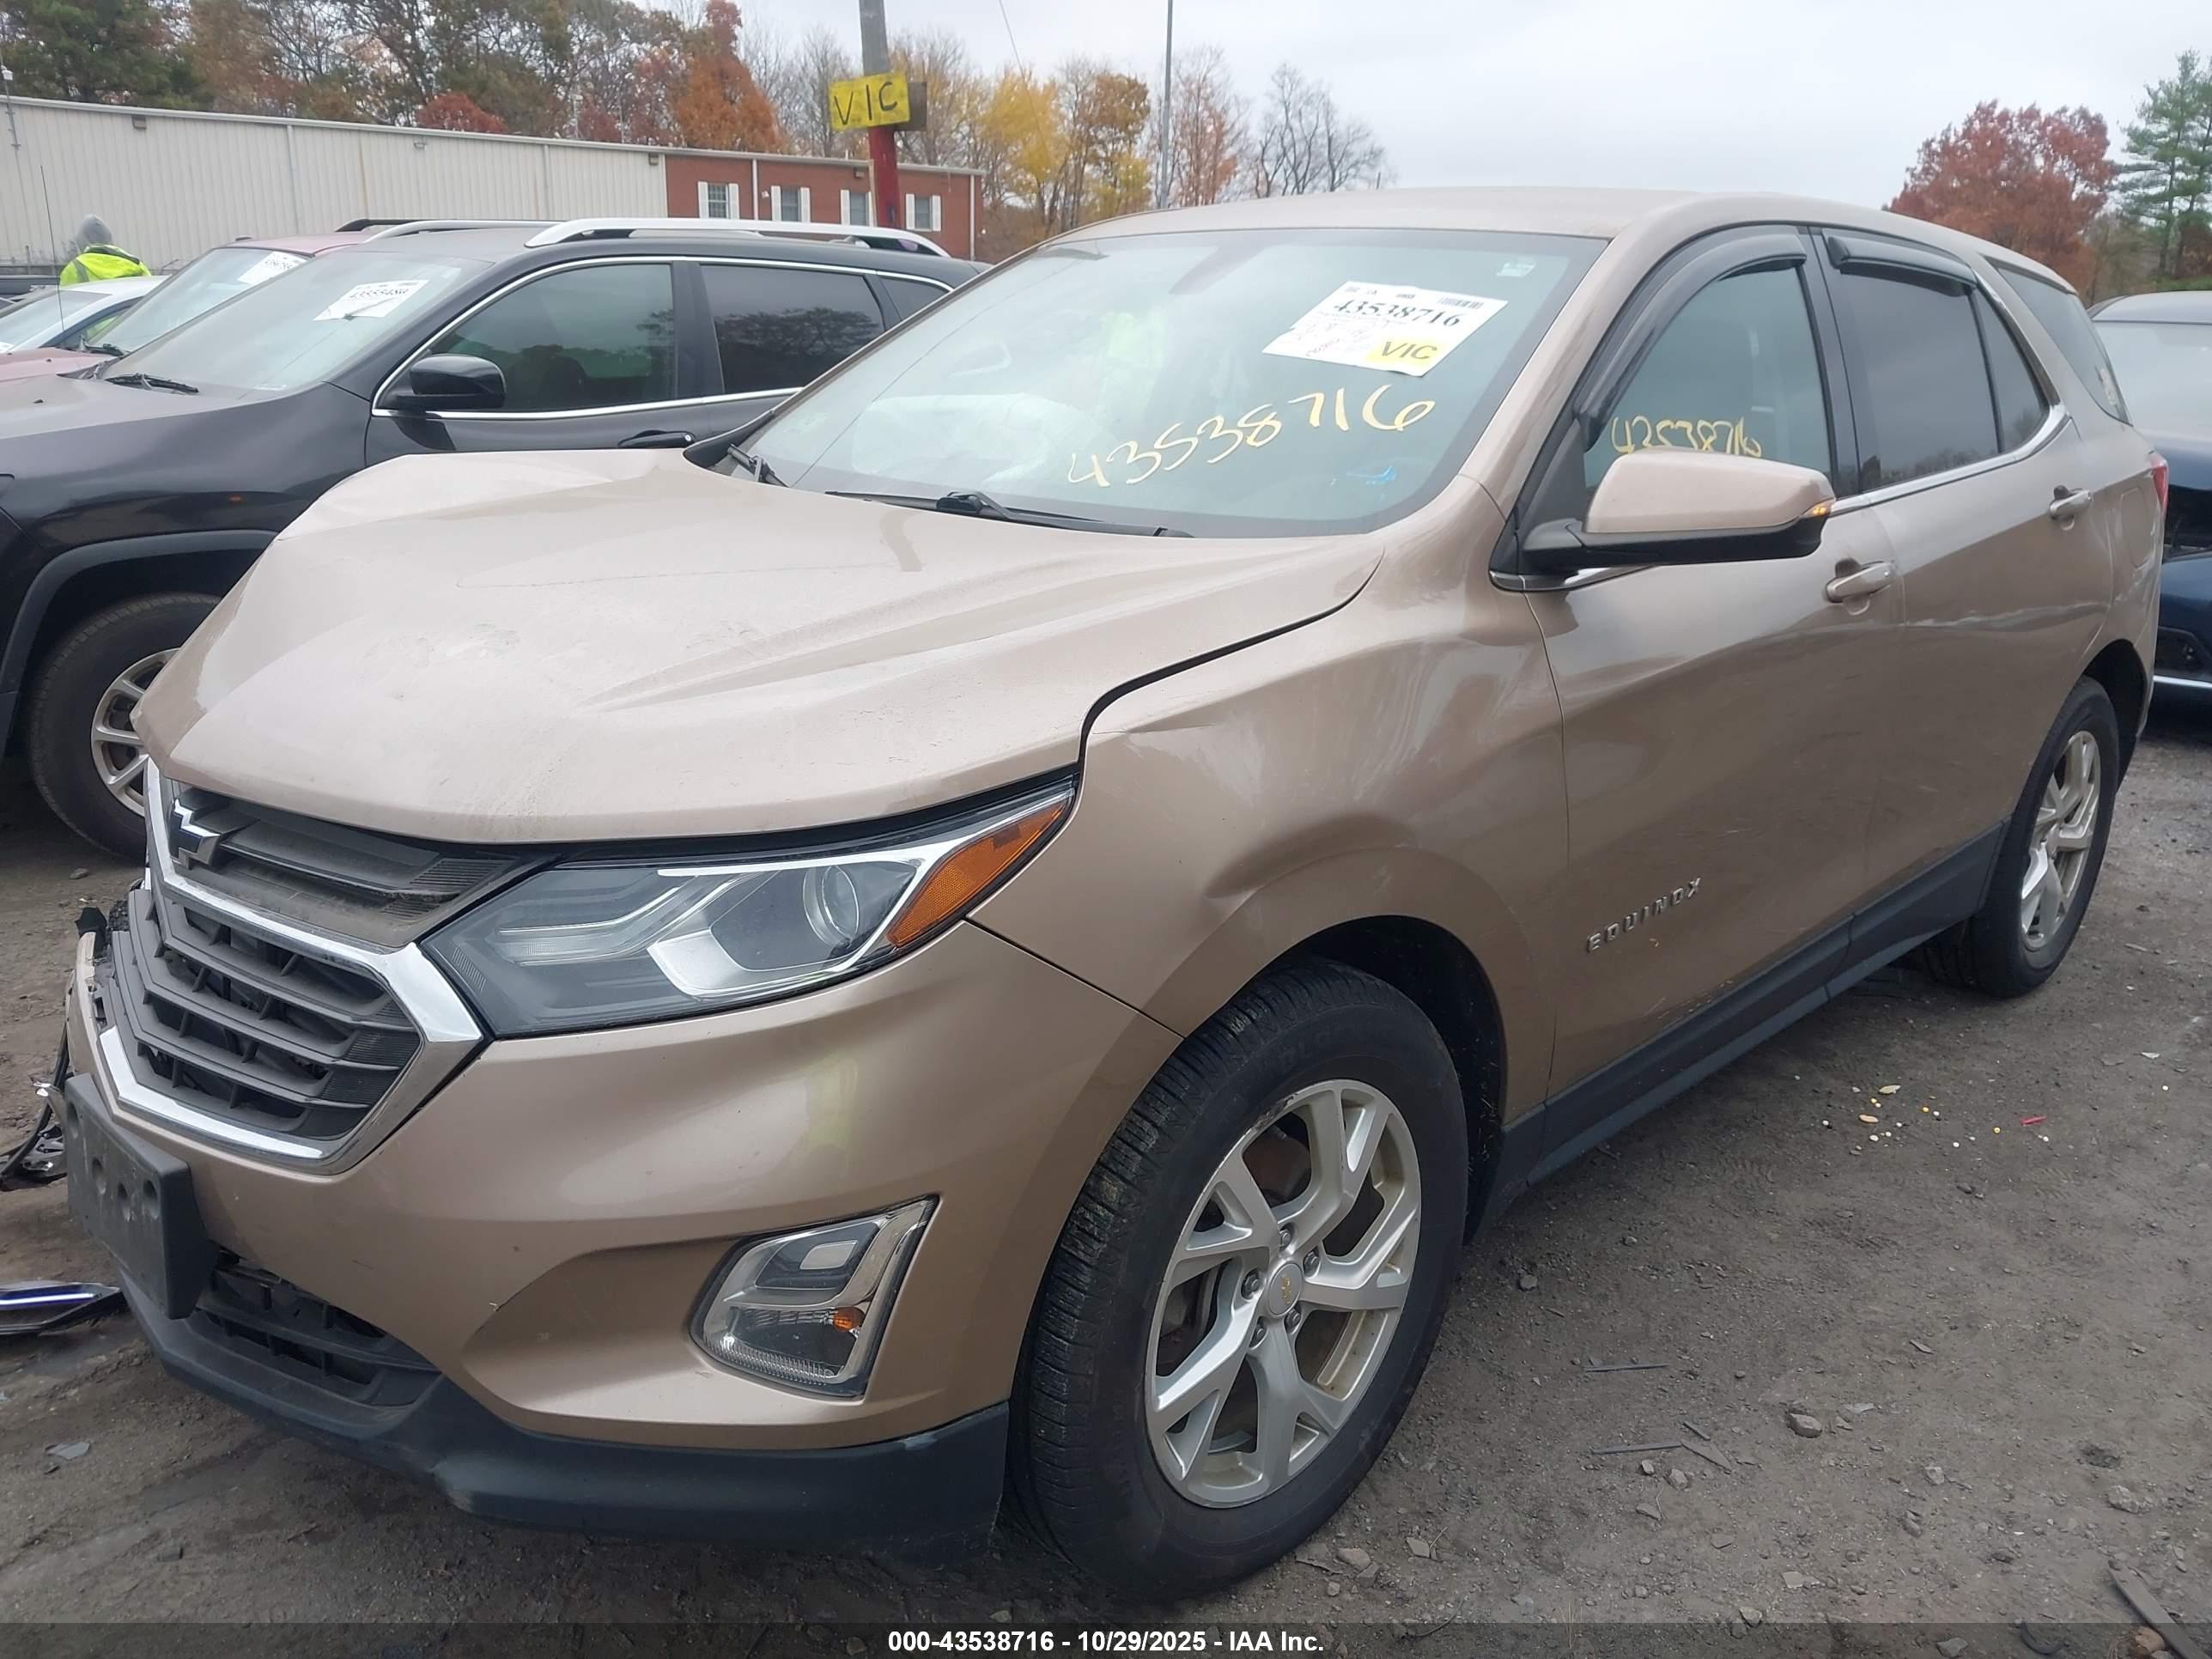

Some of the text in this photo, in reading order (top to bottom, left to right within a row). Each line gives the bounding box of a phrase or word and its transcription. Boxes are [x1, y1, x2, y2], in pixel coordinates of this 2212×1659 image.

[834, 81, 898, 125] VIC
[1334, 298, 1461, 326] 43538716
[1381, 341, 1437, 360] VIC
[1067, 385, 1436, 487] 43538716
[1587, 877, 1701, 953] EQUINOX
